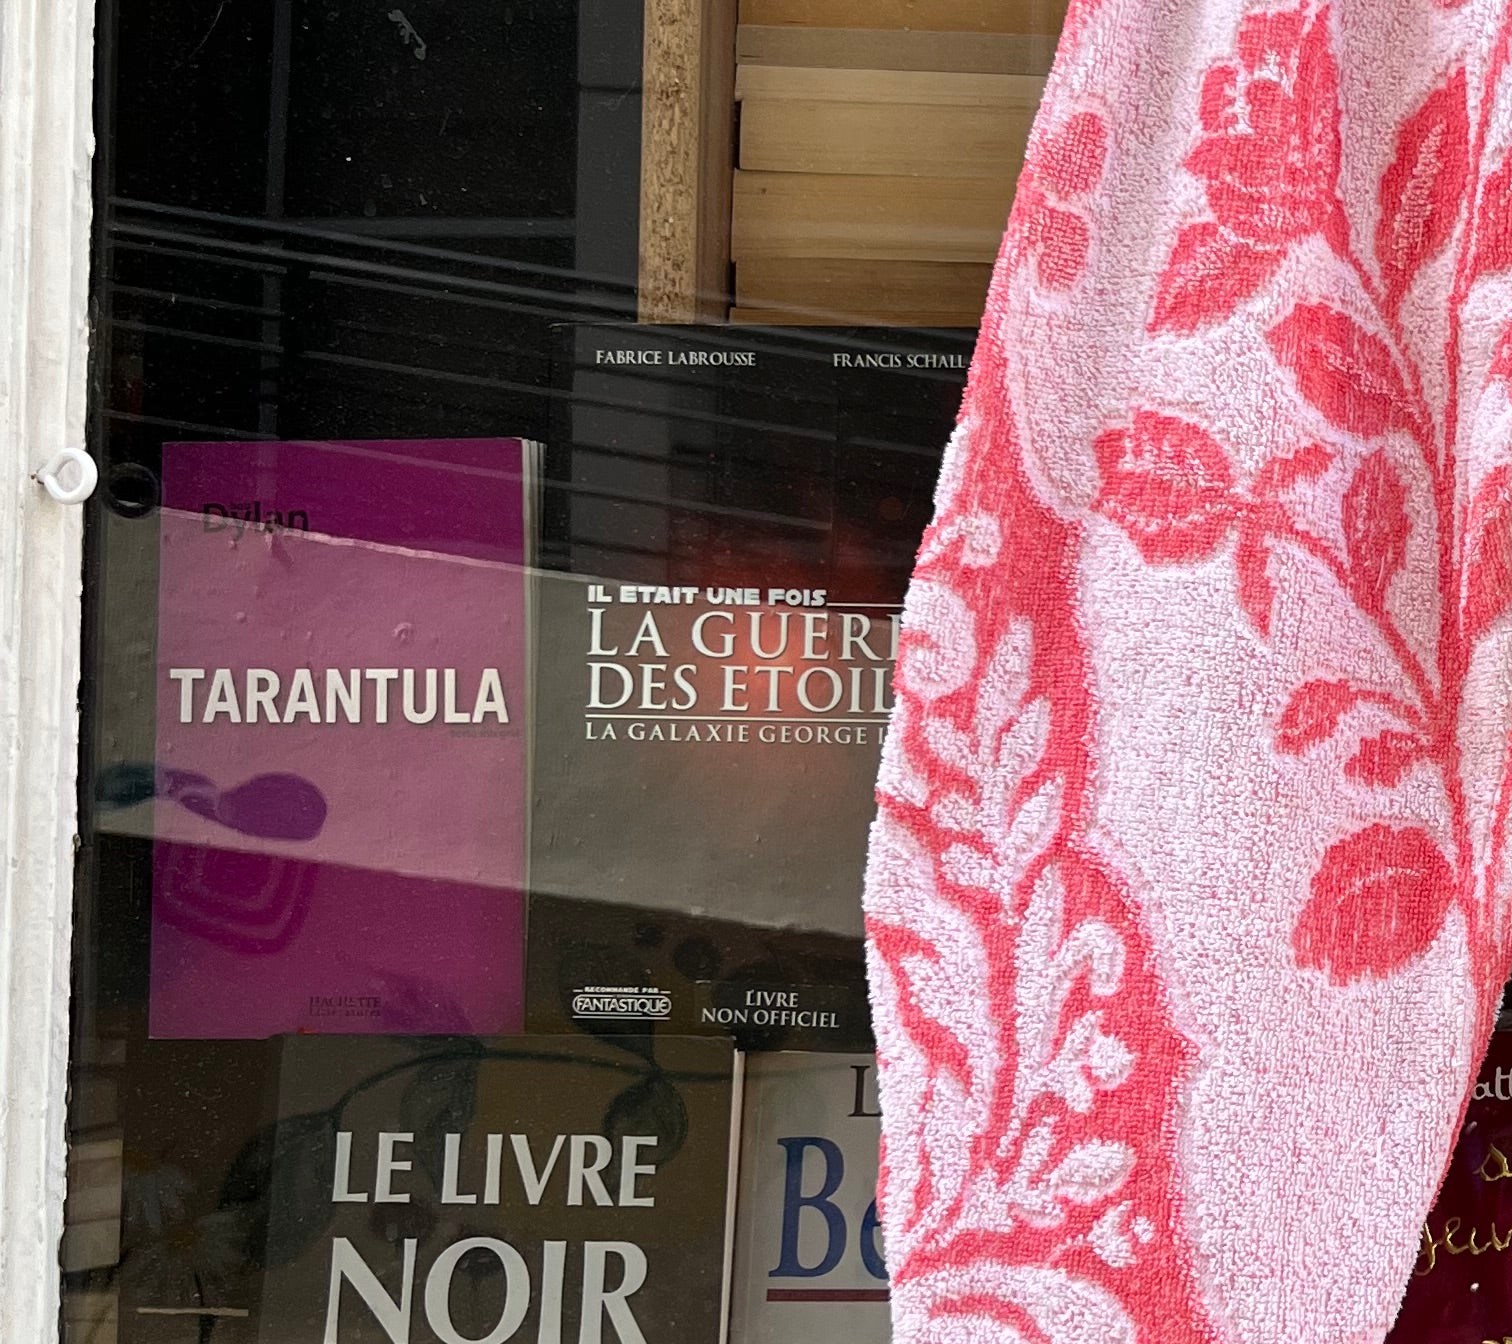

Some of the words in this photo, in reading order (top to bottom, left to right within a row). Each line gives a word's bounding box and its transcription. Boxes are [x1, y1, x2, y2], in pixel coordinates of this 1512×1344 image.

[595, 350, 662, 366] FABRICE
[668, 351, 757, 367] LABROUSSE
[833, 353, 902, 369] FRANCIS
[587, 585, 613, 604] IL
[619, 585, 700, 605] ETAIT
[706, 588, 760, 606] UNE
[768, 589, 828, 607] FOIS
[169, 668, 510, 725] TARANTULA
[585, 662, 699, 712] DES
[585, 721, 617, 741] LA
[627, 722, 750, 743] GALAXIE
[758, 725, 869, 745] GEORGE
[575, 996, 671, 1014] FANTASTIQUE
[701, 1006, 748, 1024] NON
[753, 1010, 841, 1029] OFFICIEL
[331, 1131, 415, 1204] LE
[441, 1133, 659, 1208] LIVRE
